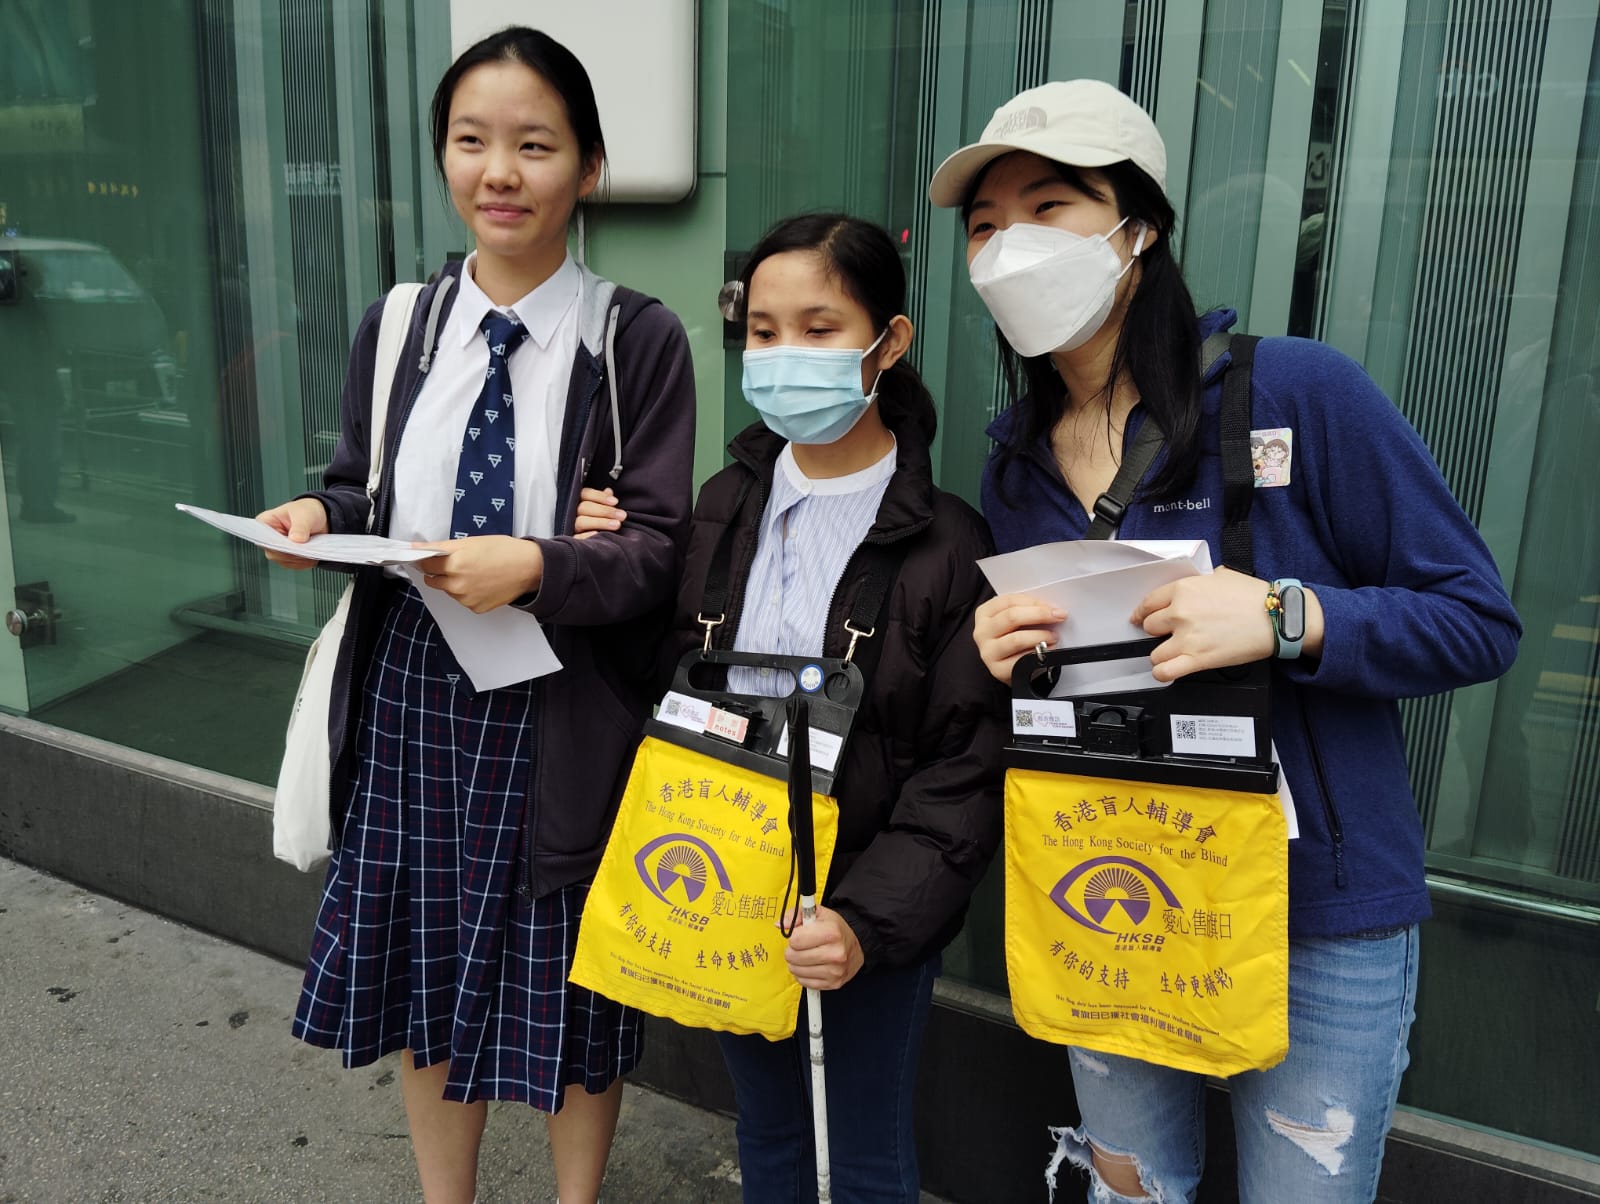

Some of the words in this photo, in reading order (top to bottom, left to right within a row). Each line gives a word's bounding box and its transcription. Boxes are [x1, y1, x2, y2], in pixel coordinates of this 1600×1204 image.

[1153, 498, 1210, 513] mont-bell
[714, 724, 737, 737] notes
[659, 778, 779, 836] 香港盲人輔導會
[1053, 795, 1217, 845] 香港盲人輔導會
[645, 799, 658, 814] The
[658, 805, 675, 822] Hong
[677, 812, 696, 832] Kong
[696, 818, 727, 838] Society
[728, 829, 741, 844] for
[744, 835, 756, 849] the
[759, 840, 785, 857] Blind
[1042, 834, 1058, 848] The
[1062, 834, 1084, 850] Hong
[1089, 835, 1113, 851] Kong
[1115, 836, 1153, 855] Society
[1159, 842, 1173, 857] for
[1180, 846, 1196, 860] the
[1201, 848, 1229, 868] Blind
[670, 905, 710, 927] HKSB
[1162, 908, 1232, 942] 愛心售旗日
[619, 902, 672, 960] 有你的支持
[695, 943, 769, 971] 生命更精彩
[1116, 932, 1167, 946] HKSB
[1049, 939, 1131, 991] 有你的支持
[1160, 966, 1233, 999] 生命更精彩
